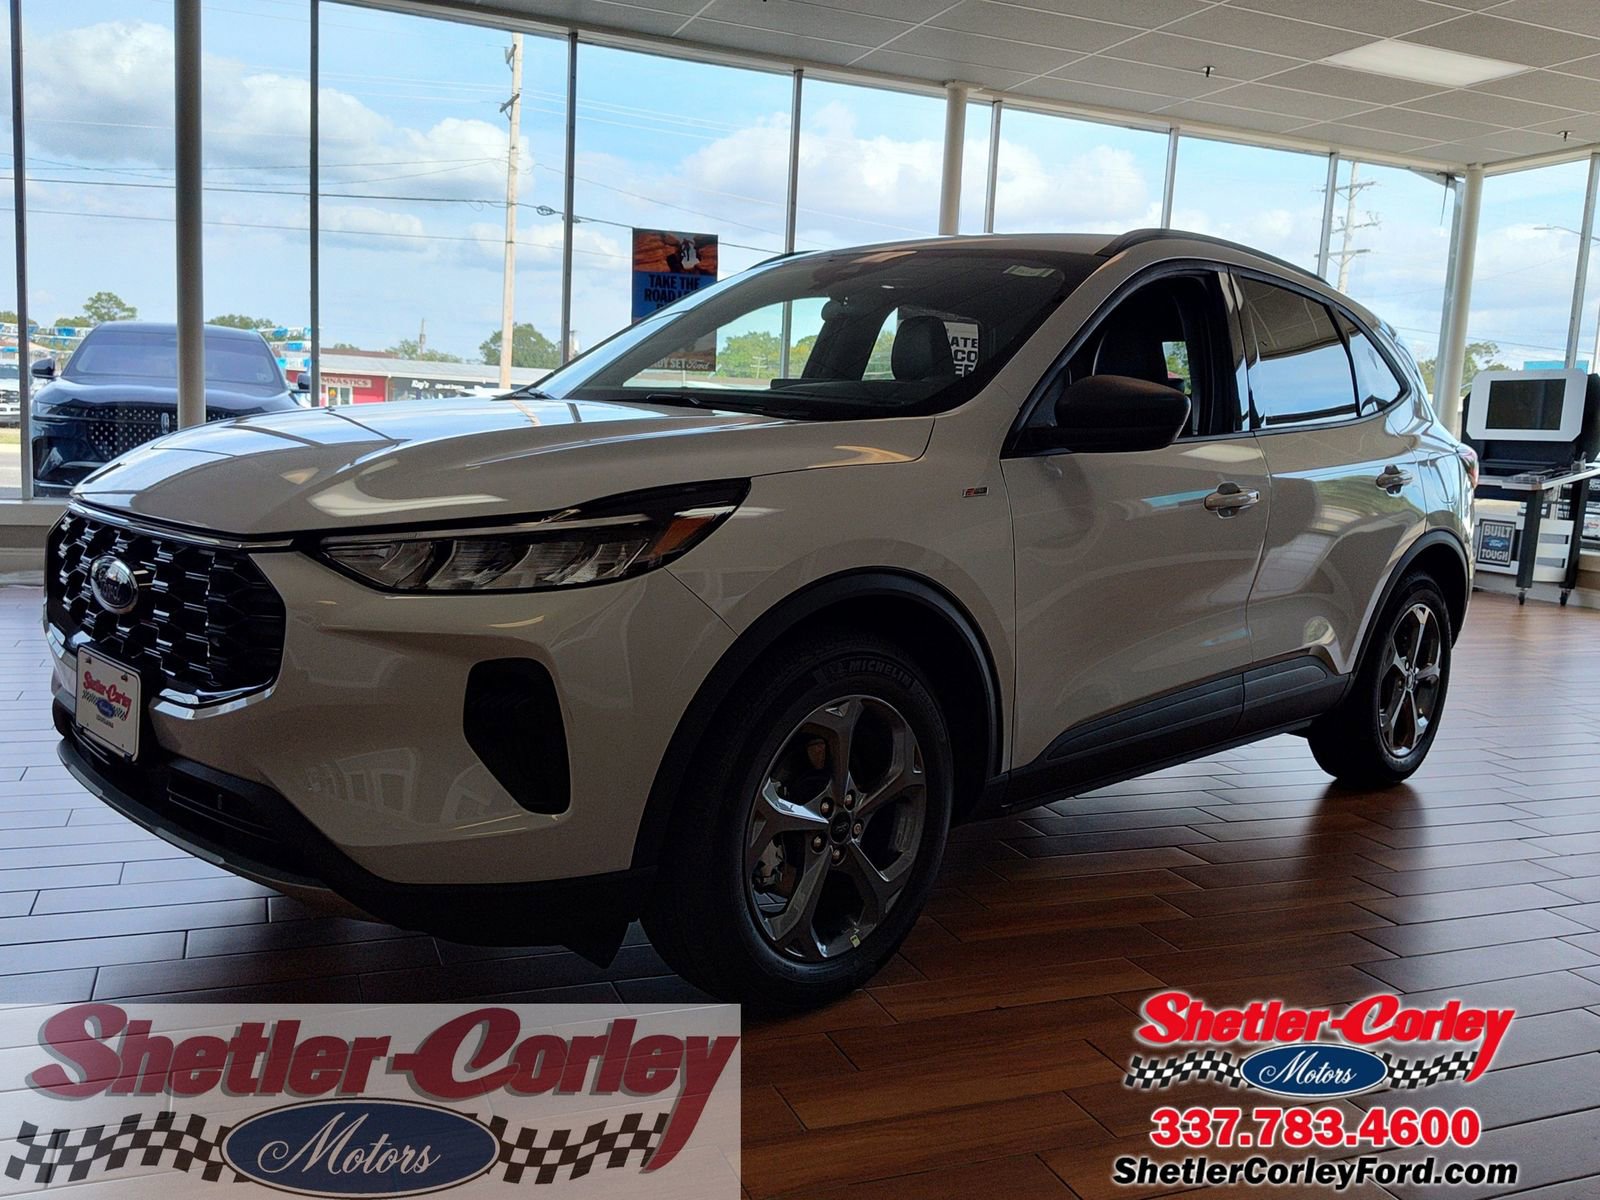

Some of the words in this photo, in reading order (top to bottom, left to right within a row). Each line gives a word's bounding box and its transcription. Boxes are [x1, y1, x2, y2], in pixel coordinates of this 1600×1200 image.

[648, 274, 676, 289] TAKE
[679, 277, 700, 290] THE
[644, 288, 675, 302] ROAD
[950, 336, 978, 348] ATE
[671, 358, 686, 369] SET
[321, 377, 369, 386] MNASTICS
[1484, 525, 1512, 538] BUILT
[1481, 548, 1508, 561] TOUGH
[848, 660, 914, 685] MICHELIN
